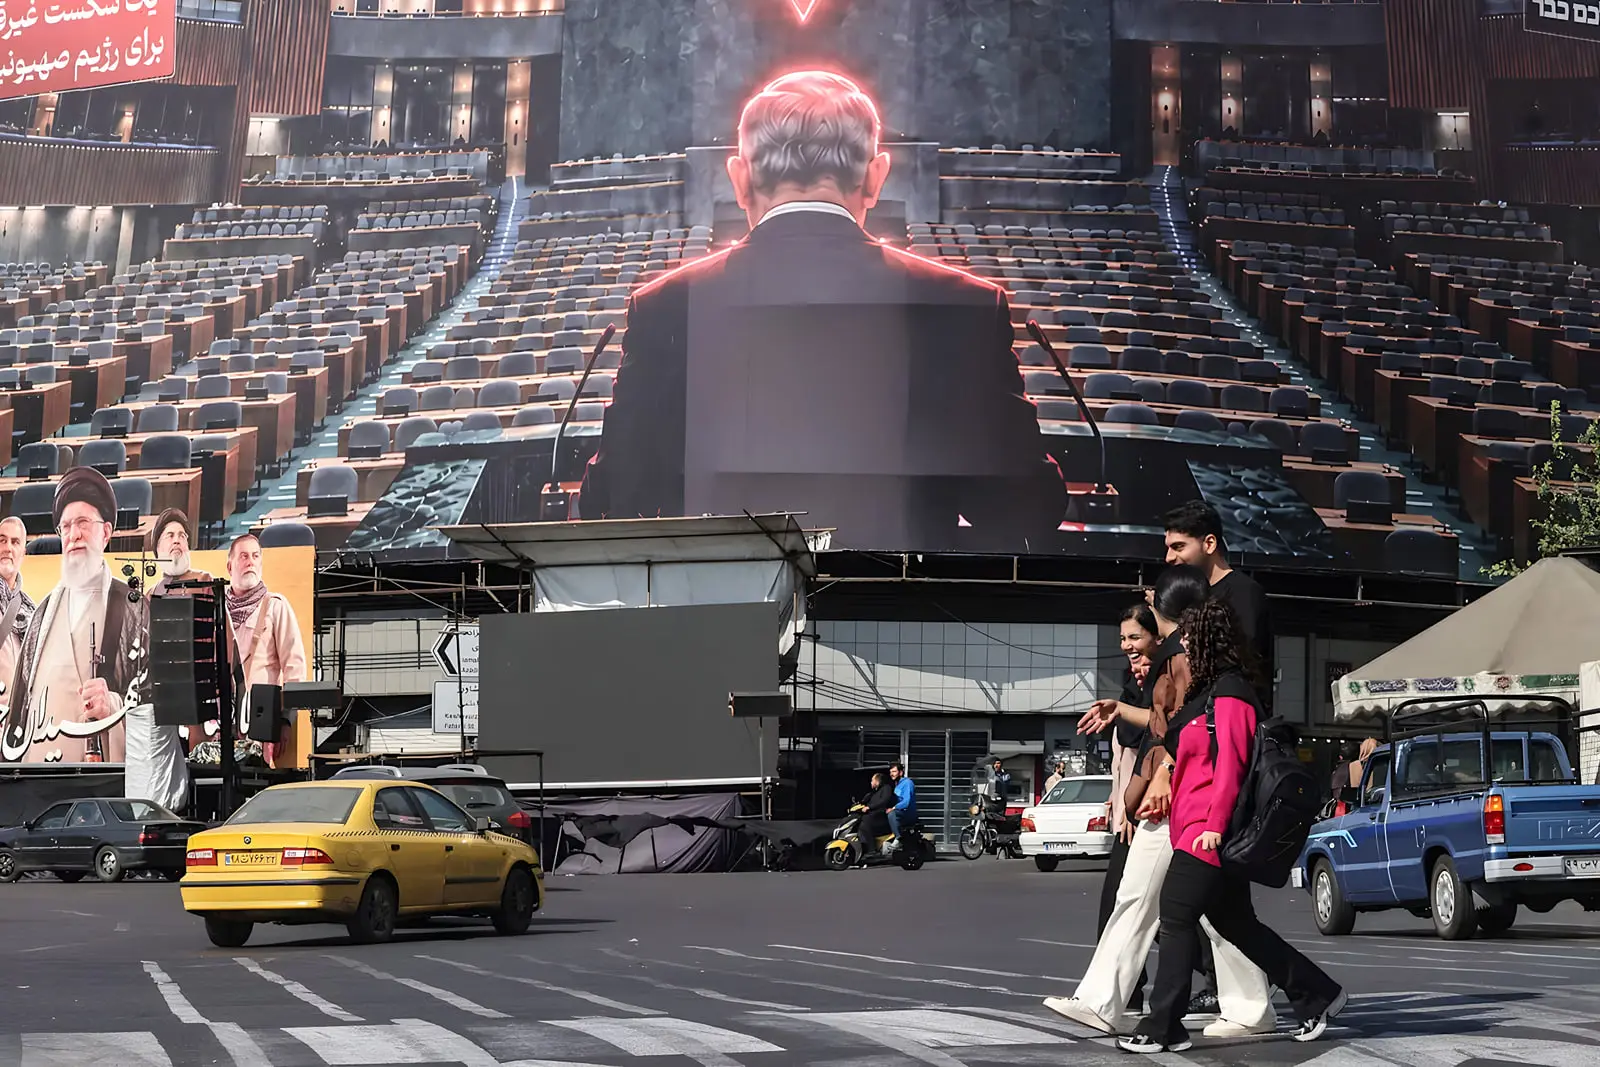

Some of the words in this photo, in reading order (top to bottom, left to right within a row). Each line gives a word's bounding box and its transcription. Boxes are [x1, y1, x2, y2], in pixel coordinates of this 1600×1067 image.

[1572, 2, 1600, 26] כם
[74, 36, 120, 82] رژیم
[124, 26, 165, 66] برای
